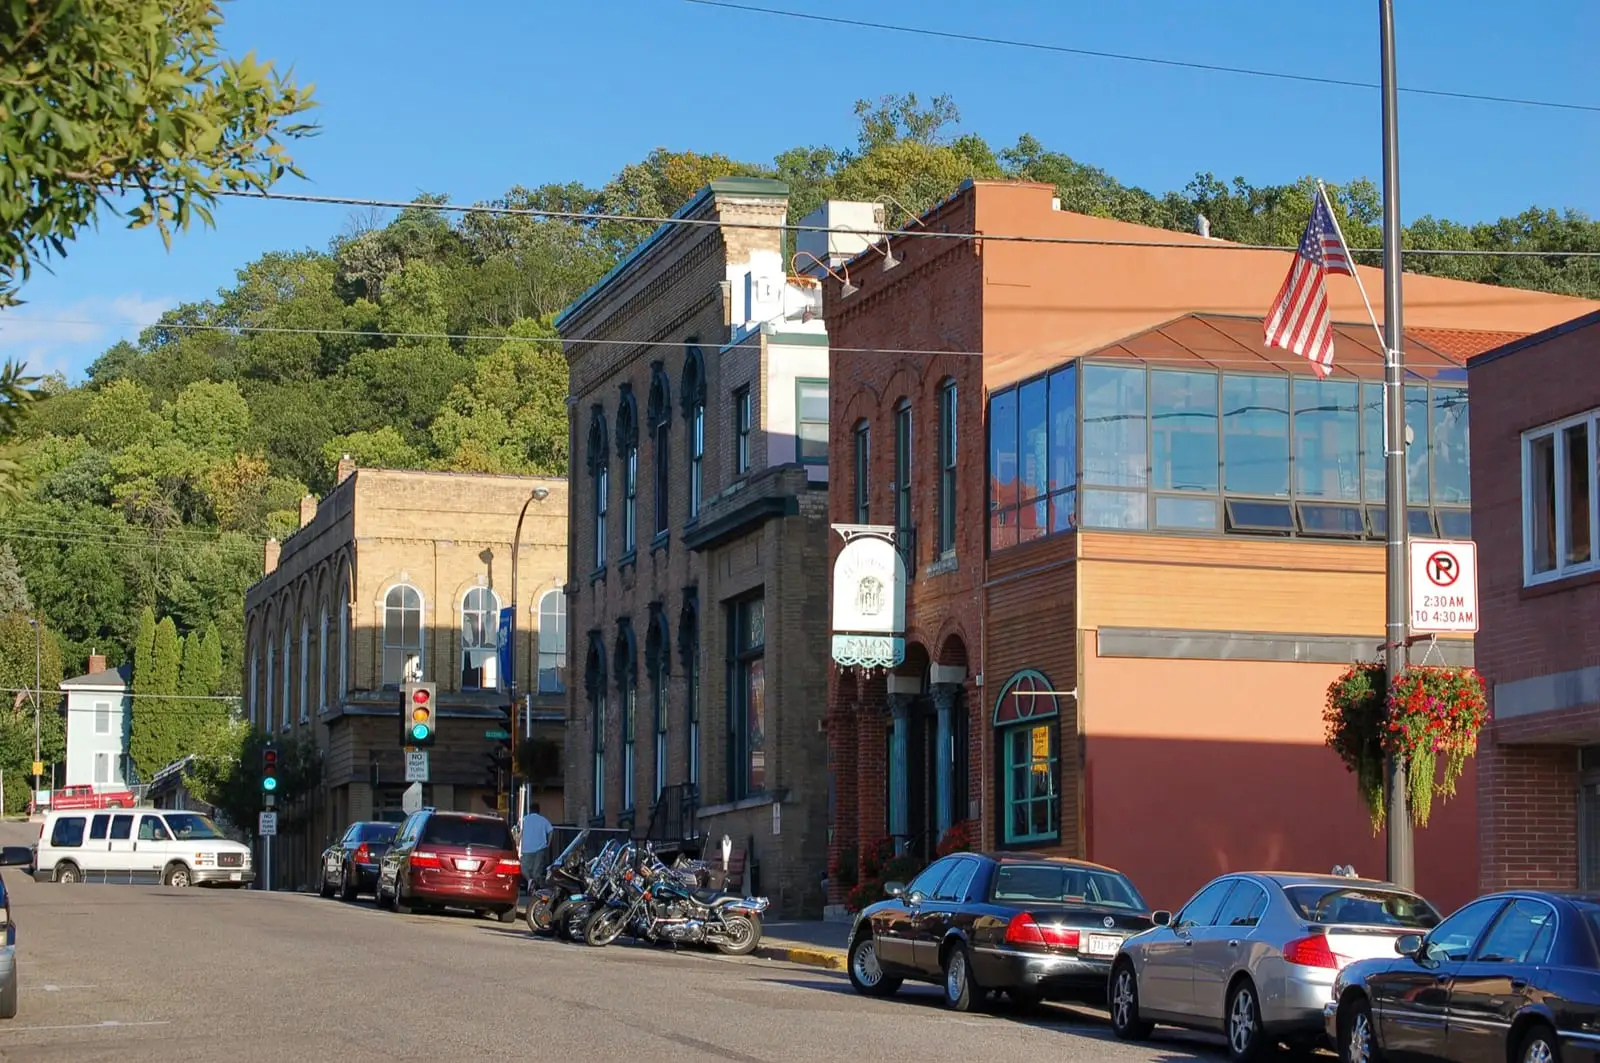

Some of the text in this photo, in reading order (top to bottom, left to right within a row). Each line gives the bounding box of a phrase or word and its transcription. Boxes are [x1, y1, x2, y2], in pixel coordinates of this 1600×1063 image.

[1424, 595, 1464, 607] 2:30 AM
[1416, 610, 1473, 623] TO 4:30 AM
[847, 639, 891, 648] SALON
